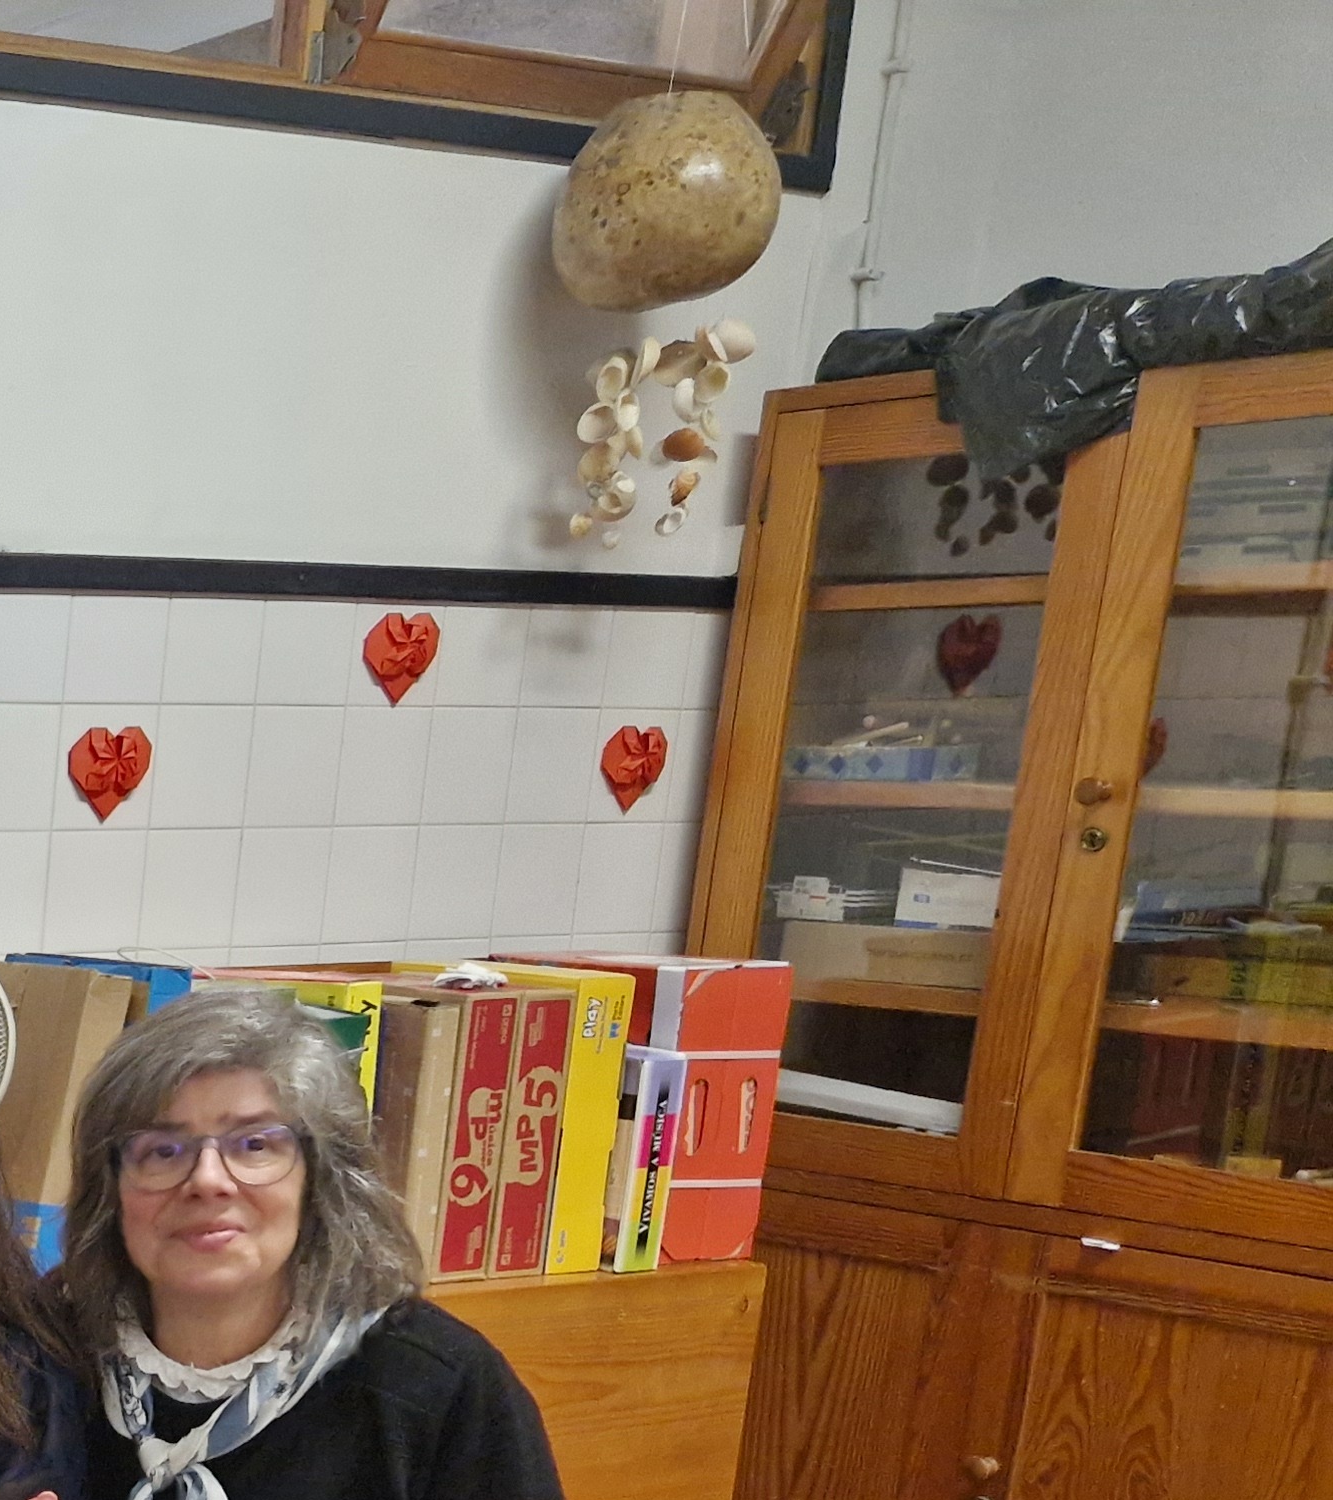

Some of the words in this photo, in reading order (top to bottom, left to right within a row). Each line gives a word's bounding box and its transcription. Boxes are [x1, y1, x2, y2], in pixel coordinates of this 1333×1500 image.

[582, 996, 603, 1038] Play
[523, 1077, 558, 1108] 5
[516, 1114, 539, 1172] MP
[651, 1156, 660, 1167] A
[450, 1163, 489, 1199] 6
